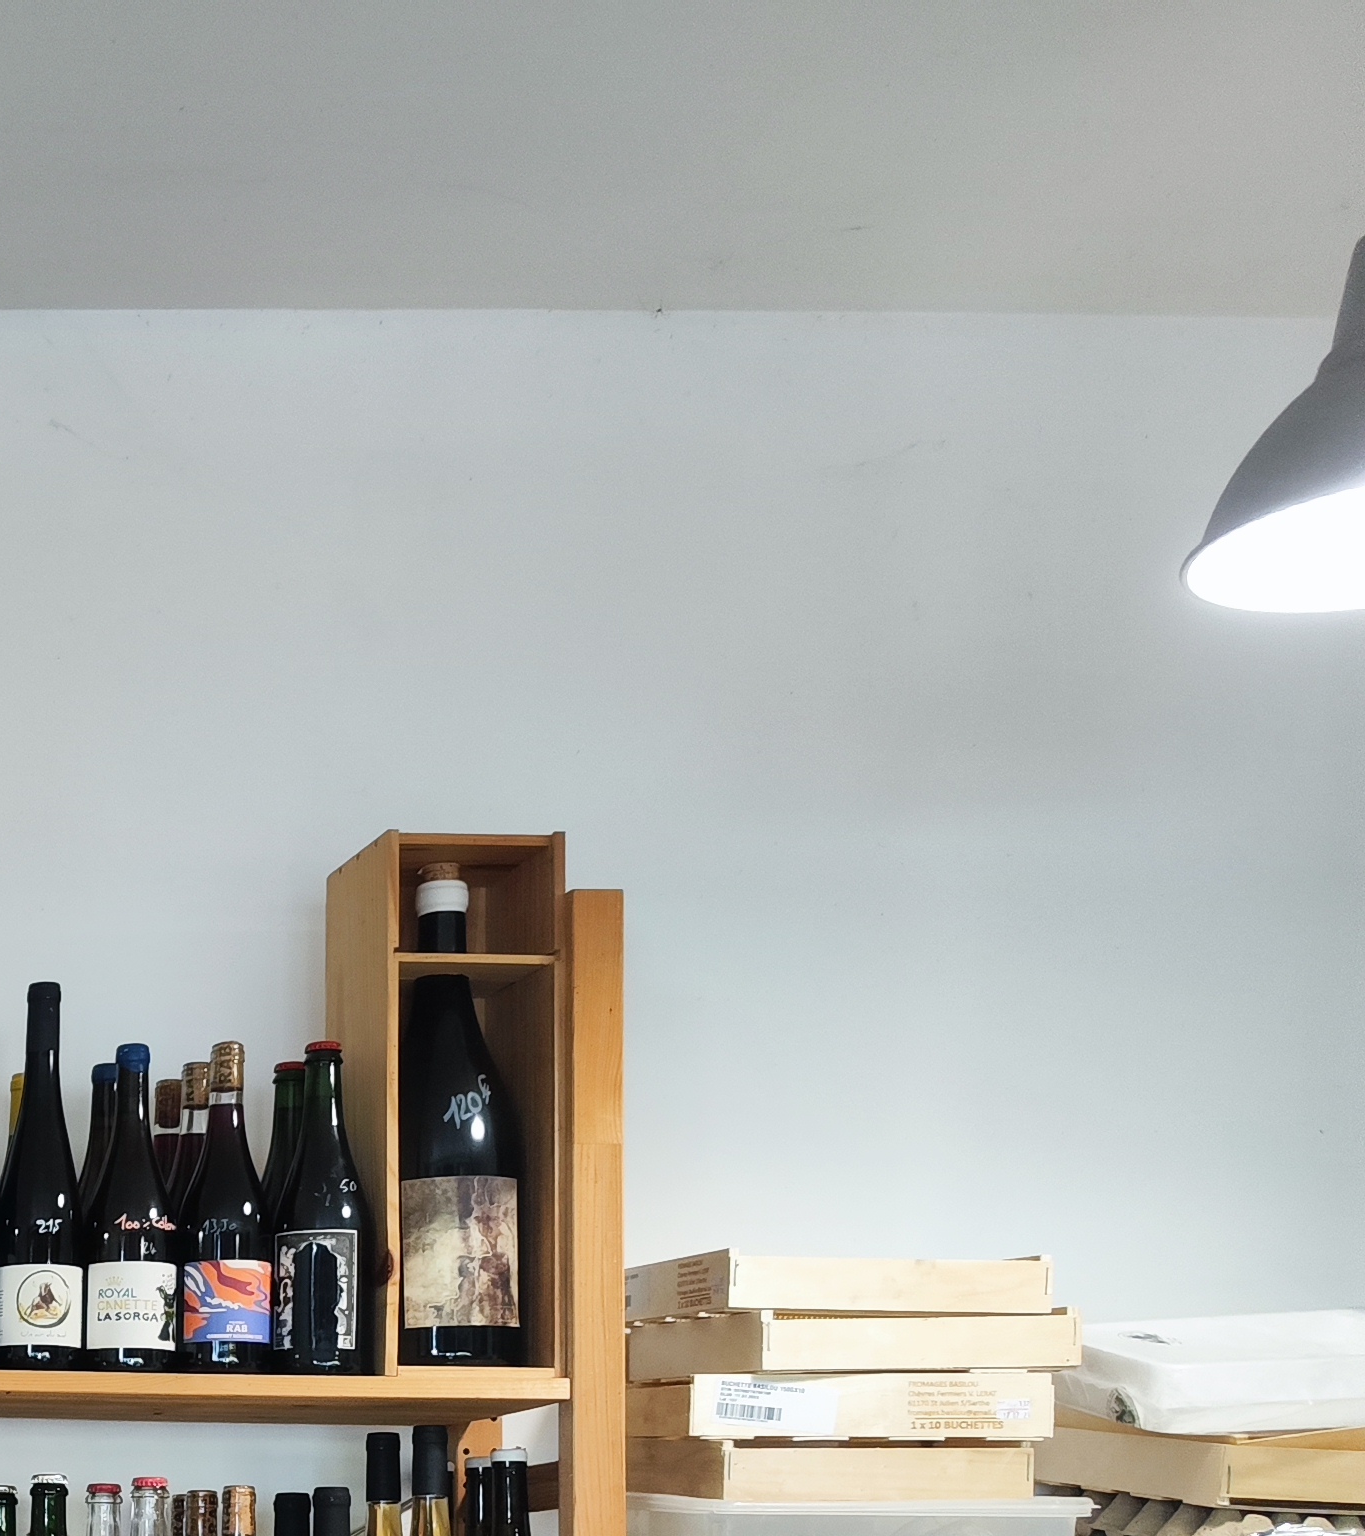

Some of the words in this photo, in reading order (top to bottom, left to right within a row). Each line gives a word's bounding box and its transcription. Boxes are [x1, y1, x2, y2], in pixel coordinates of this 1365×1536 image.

[97, 1288, 138, 1299] ROYAL
[97, 1300, 159, 1312] CANETTE
[97, 1313, 112, 1323] LA
[114, 1313, 159, 1324] SORGA
[226, 1324, 249, 1333] RAB
